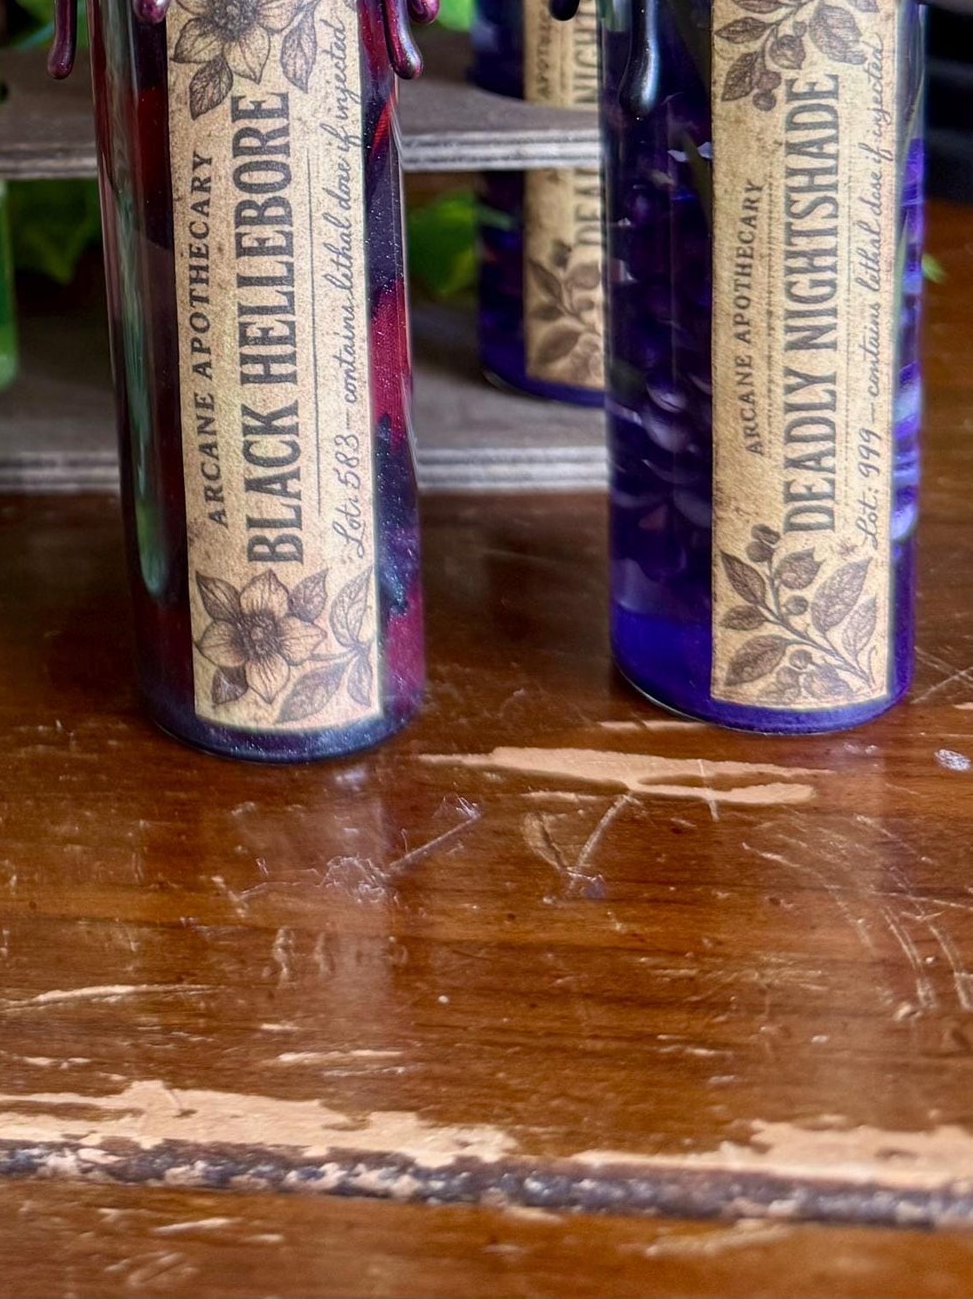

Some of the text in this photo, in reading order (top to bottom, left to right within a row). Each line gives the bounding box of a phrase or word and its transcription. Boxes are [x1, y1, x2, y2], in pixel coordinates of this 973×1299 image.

[321, 18, 363, 121] injected
[863, 32, 892, 137] injected
[318, 122, 365, 153] if
[856, 140, 893, 164] if
[323, 158, 353, 211] dose
[856, 171, 883, 218] dose
[320, 211, 356, 297] lethal
[858, 218, 882, 294] lethal
[188, 150, 228, 530] ARCANE APOTHECARY
[230, 91, 304, 566] BLACK HELLEBORE
[733, 179, 765, 457] ARCANE APOTHECARY
[783, 73, 840, 533] DEADLY NIGHTSHADE
[332, 300, 358, 404] contains
[860, 303, 881, 398] contains
[334, 434, 360, 489] 583
[858, 427, 882, 479] 999
[855, 488, 879, 551] Lot:
